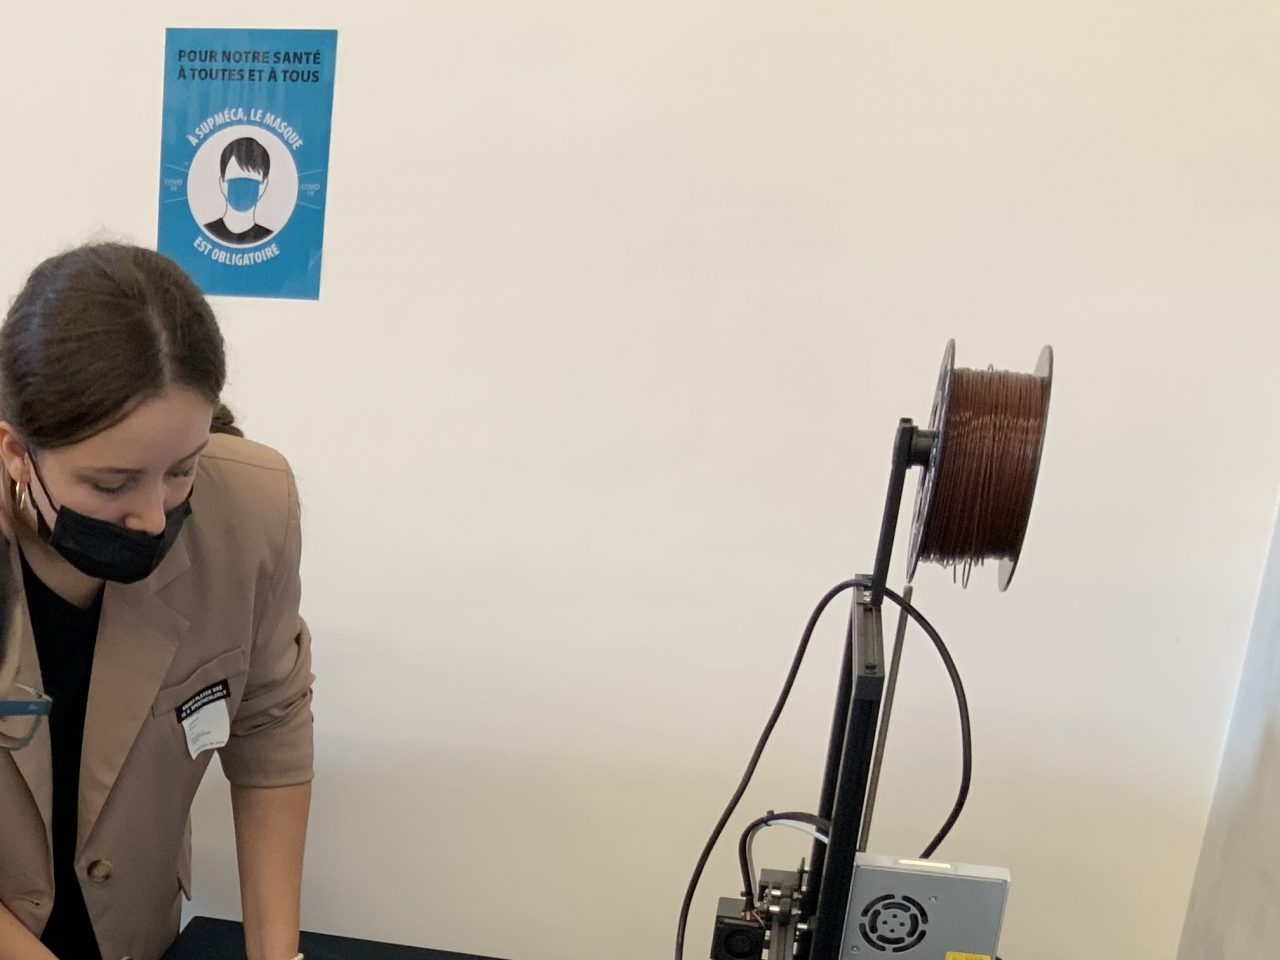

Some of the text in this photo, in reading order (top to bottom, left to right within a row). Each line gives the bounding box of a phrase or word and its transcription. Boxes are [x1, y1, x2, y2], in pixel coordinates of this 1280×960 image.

[178, 50, 321, 65] POUR NOTRE SANTÉ
[177, 65, 320, 82] À TOUTES ET À TOUS
[186, 107, 303, 150] À SUPMÉCA, LE MASQUE
[193, 236, 280, 266] EST OBLIGATOIRE
